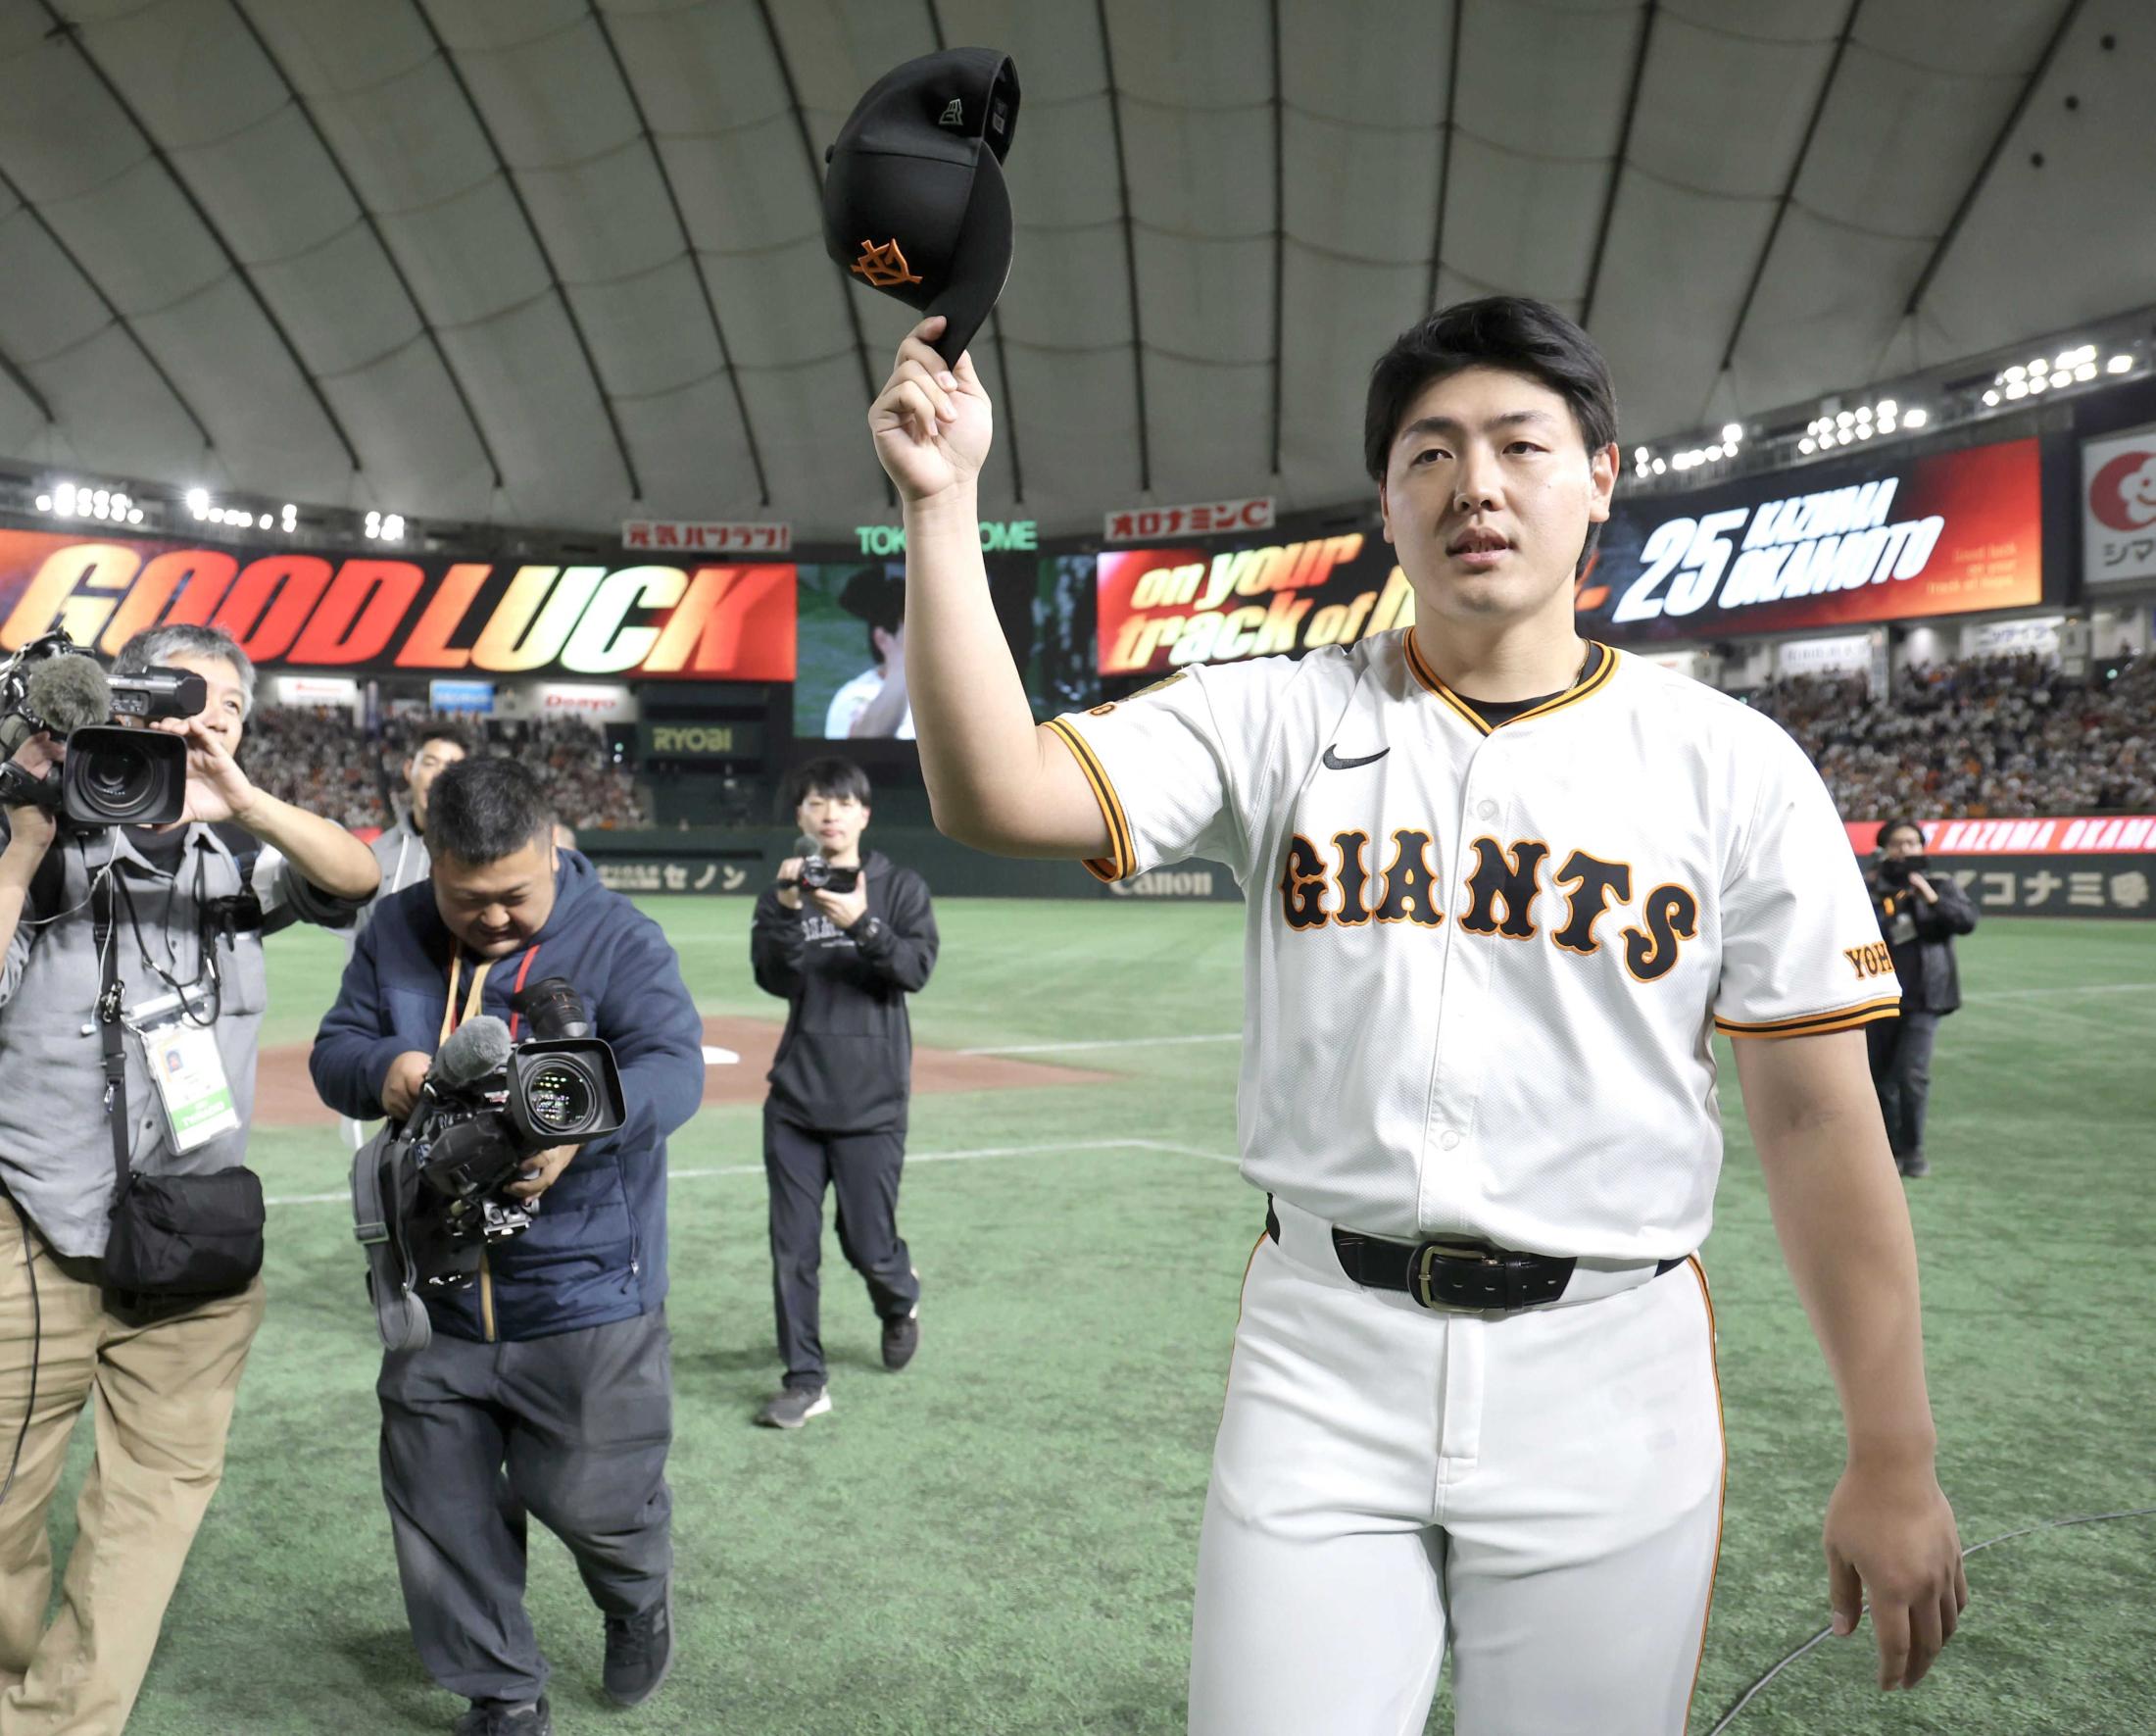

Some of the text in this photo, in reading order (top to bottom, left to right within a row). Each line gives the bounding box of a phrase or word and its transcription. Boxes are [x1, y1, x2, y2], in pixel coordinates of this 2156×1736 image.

[855, 521, 1039, 555] TOK OME
[1111, 500, 1270, 539] オロナミンC
[1612, 476, 1899, 623] 25 KAZUMA
[1130, 563, 1205, 610] on
[1194, 532, 1365, 612] your
[1717, 515, 1945, 610] OKAMOTO
[0, 542, 786, 673] GOOD LUCK
[1107, 589, 1315, 670] track
[1303, 591, 1378, 650] of
[652, 726, 733, 753] RYOBI
[1278, 828, 1700, 983] GIANTS
